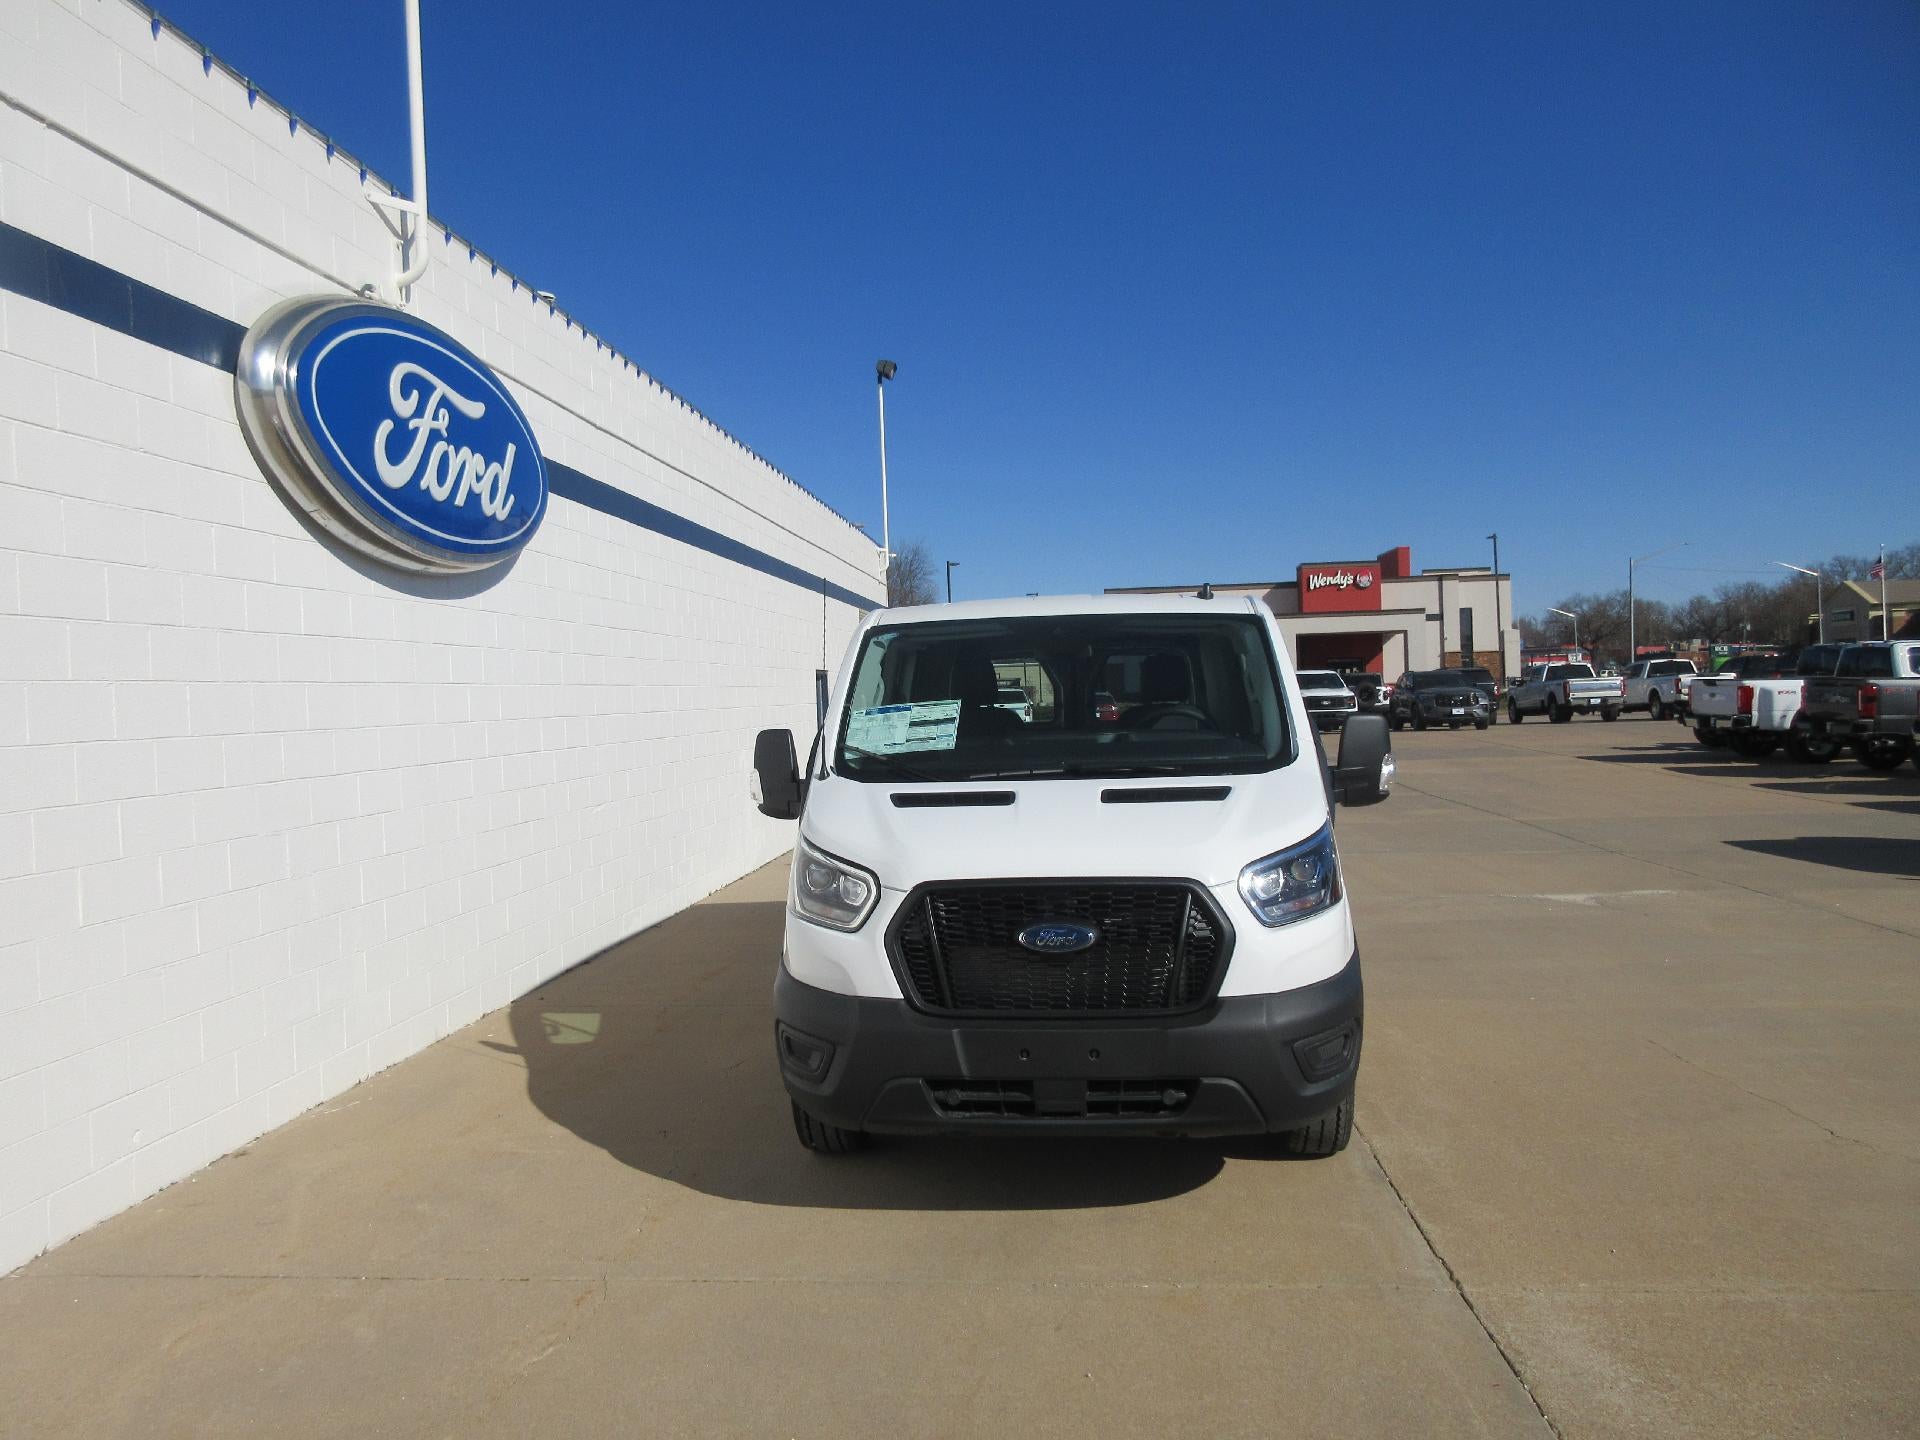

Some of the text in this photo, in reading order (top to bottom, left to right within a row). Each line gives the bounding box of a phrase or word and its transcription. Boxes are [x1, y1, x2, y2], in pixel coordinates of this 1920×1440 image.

[374, 362, 516, 521] Ford
[1309, 569, 1354, 590] Wendy's
[1036, 928, 1078, 946] Ford
